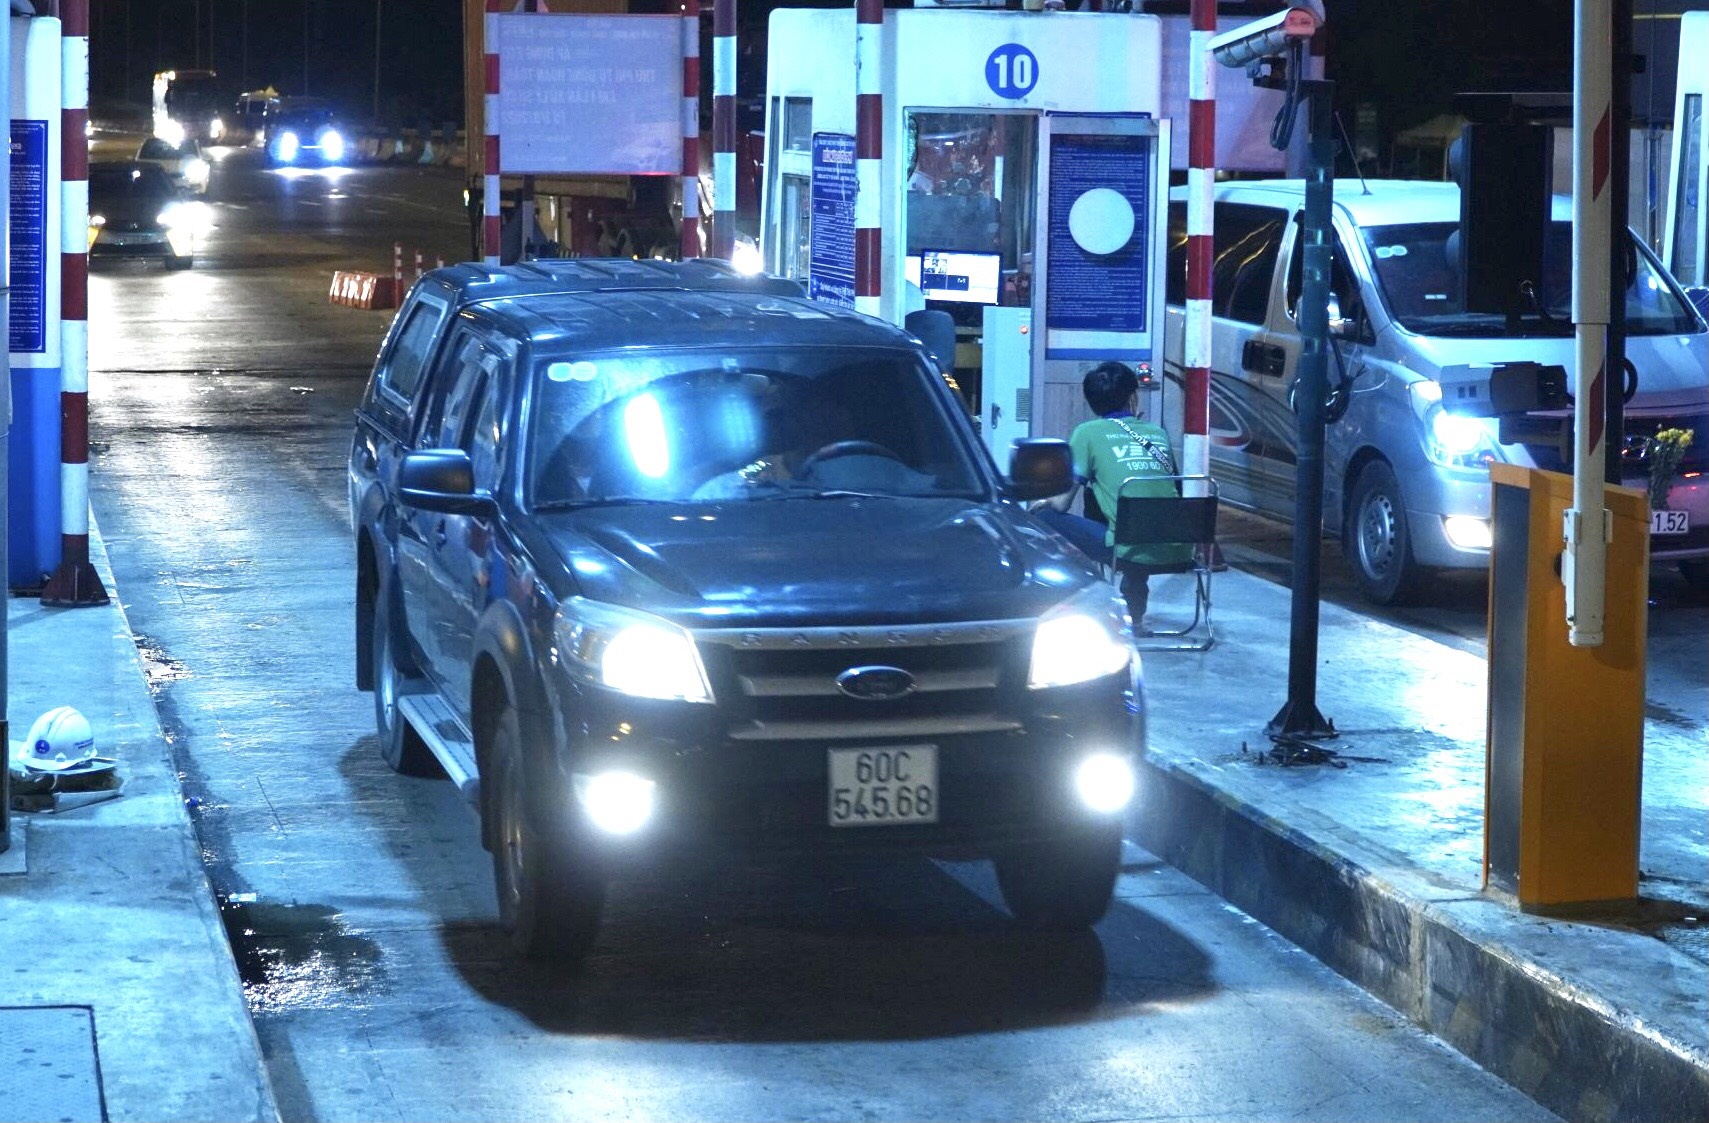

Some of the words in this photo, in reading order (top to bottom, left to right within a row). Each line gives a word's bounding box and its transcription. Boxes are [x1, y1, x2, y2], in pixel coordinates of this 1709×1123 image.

[994, 54, 1032, 89] 10
[1112, 445, 1168, 458] VEC
[1127, 461, 1148, 470] 1900
[857, 751, 911, 784] 60C
[833, 785, 932, 820] 545.68
